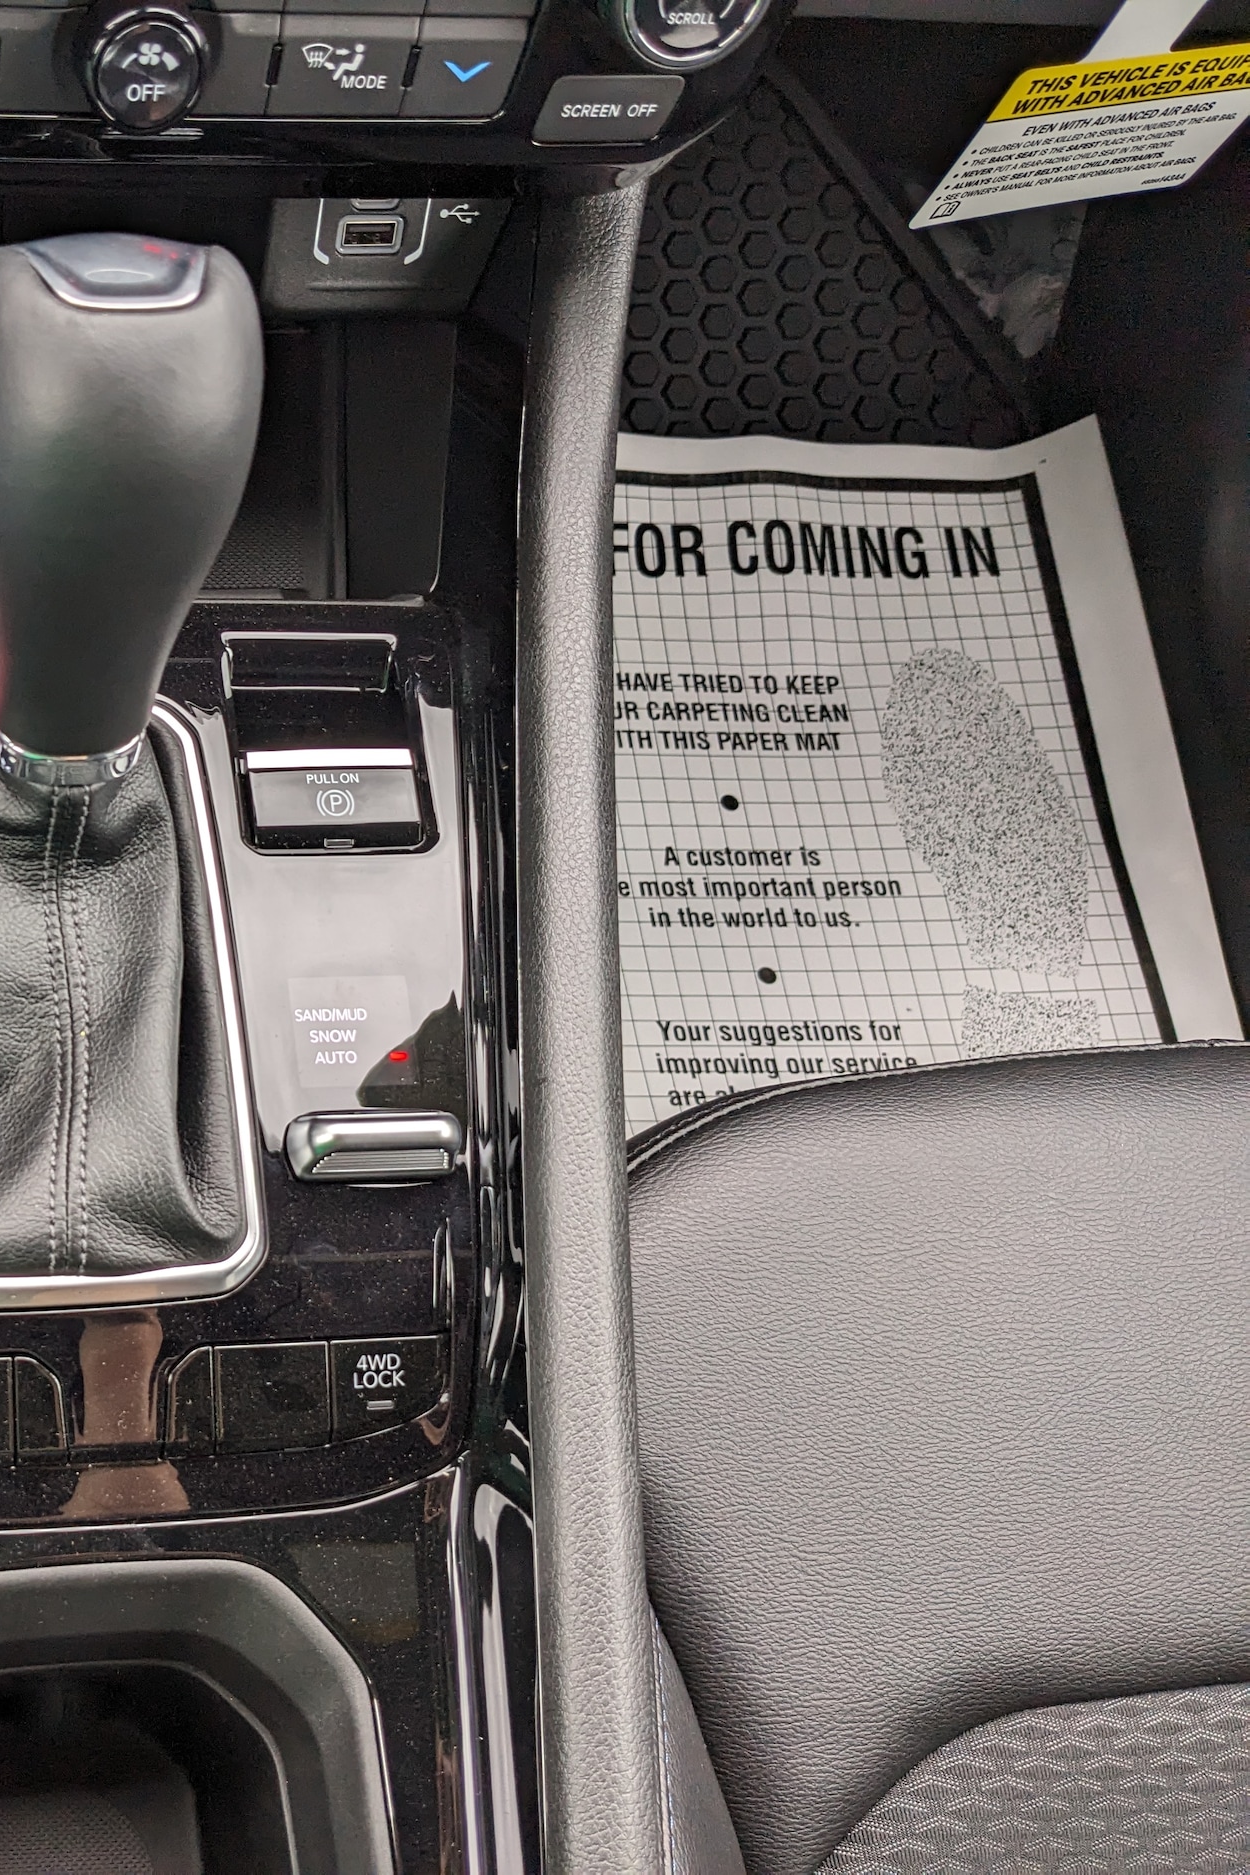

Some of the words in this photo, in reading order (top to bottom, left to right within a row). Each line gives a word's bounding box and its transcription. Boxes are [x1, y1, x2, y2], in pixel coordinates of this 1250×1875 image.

[667, 10, 716, 27] SCROLL
[341, 74, 388, 91] MODE
[1027, 75, 1077, 95] THIS
[1080, 64, 1168, 88] VEHICLE
[1166, 61, 1191, 77] IS
[127, 83, 166, 103] OFF
[1012, 95, 1071, 115] WITH
[1068, 80, 1185, 107] ADVANCED
[1182, 76, 1220, 92] AIR
[1218, 72, 1250, 88] BA
[561, 103, 621, 119] SCREEN
[627, 103, 658, 119] OFF
[1023, 124, 1058, 137] EVEN
[1058, 118, 1093, 131] WITH
[1092, 110, 1160, 126] ADVANCED
[1158, 106, 1181, 117] AIR
[1182, 102, 1217, 114] BAGS
[980, 144, 1022, 155] CHILDREN
[1023, 140, 1041, 148] CAN
[1042, 137, 1055, 146] BE
[1055, 133, 1084, 144] KILLED
[1084, 131, 1098, 139] OR
[1097, 125, 1143, 138] SERIOUSLY
[1176, 119, 1190, 127] BY
[1189, 117, 1205, 125] THE
[961, 168, 994, 179] NEVER
[993, 165, 1012, 174] PUT
[1073, 151, 1099, 162] CHILD
[1099, 148, 1120, 157] SEAT
[1130, 144, 1147, 153] THE
[972, 159, 988, 167] THE
[988, 155, 1014, 164] BACK
[1015, 151, 1041, 160] SEAT
[1050, 146, 1066, 154] THE
[1066, 141, 1102, 153] SAFEST
[1100, 137, 1128, 147] PLACE
[1128, 135, 1144, 143] FOR
[944, 194, 962, 202] SEE
[961, 187, 1000, 199] OWNER'S
[999, 181, 1035, 192] MANUAL
[1036, 178, 1054, 187] FOR
[1052, 173, 1078, 184] MORE
[1077, 163, 1136, 181] INFORMATION
[1133, 162, 1162, 172] ABOUT
[1159, 159, 1177, 169] AIR
[953, 178, 993, 191] ALWAYS
[992, 175, 1012, 184] USE
[1010, 171, 1037, 181] SEAT
[1035, 167, 1063, 178] BELTS
[1062, 163, 1081, 172] AND
[1081, 159, 1110, 170] CHILD
[612, 522, 708, 578] FOR
[727, 519, 930, 579] COMING
[945, 526, 1001, 577] IN
[616, 672, 673, 692] HAVE
[677, 673, 744, 694] TRIED
[750, 674, 778, 694] TO
[786, 675, 839, 695] KEEP
[646, 701, 770, 723] CARPETING
[777, 703, 849, 723] CLEAN
[657, 730, 710, 750] THIS
[718, 731, 789, 752] PAPER
[796, 731, 841, 752] MAT
[306, 773, 338, 785] PULL
[339, 772, 360, 784] ON
[663, 846, 680, 867] A
[686, 847, 793, 867] customer
[800, 847, 821, 867] is
[639, 877, 697, 897] most
[702, 877, 815, 901] important
[823, 879, 902, 901] person
[648, 907, 671, 928] in
[677, 908, 715, 928] the
[722, 907, 788, 928] world
[794, 908, 817, 928] to
[825, 910, 861, 928] us.
[294, 1007, 367, 1022] SAND/MUD
[309, 1029, 357, 1044] SNOW
[655, 1020, 711, 1041] Your
[719, 1020, 863, 1046] suggestions
[869, 1020, 902, 1041] for
[314, 1050, 358, 1065] AUTO
[655, 1053, 779, 1079] improving
[786, 1057, 824, 1074] our
[668, 1089, 707, 1106] are
[356, 1353, 402, 1371] 4WD
[353, 1370, 406, 1389] LOCK
